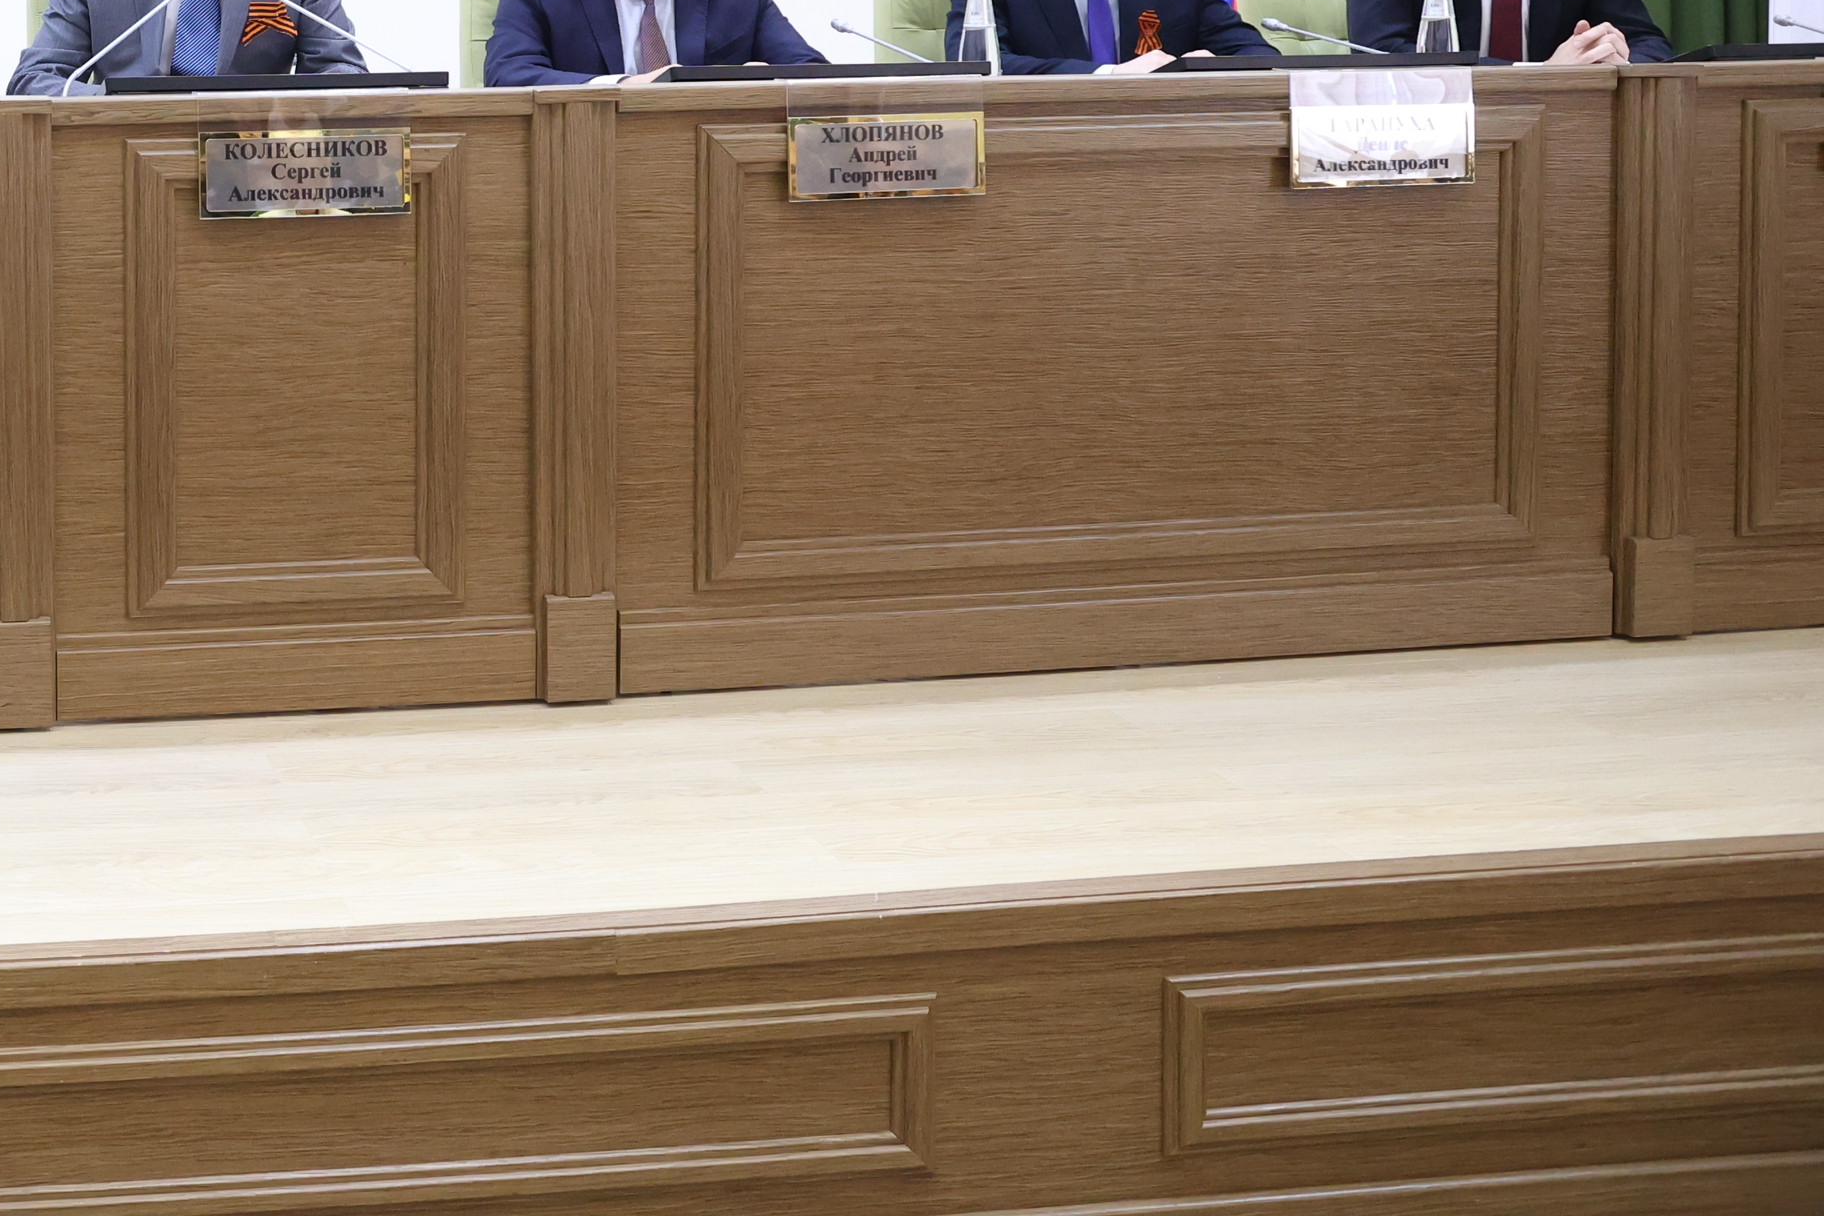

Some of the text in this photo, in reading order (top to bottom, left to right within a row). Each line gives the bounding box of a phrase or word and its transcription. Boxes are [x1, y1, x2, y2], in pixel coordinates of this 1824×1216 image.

[821, 123, 944, 143] ХЛОПЯНОВ
[224, 139, 388, 161] КОЛЕСНИКОВ
[849, 146, 917, 166] Андрей
[271, 162, 342, 183] Сергей
[1313, 156, 1449, 175] Александрович
[829, 167, 937, 186] Георгиевич
[228, 185, 384, 204] Александрович
